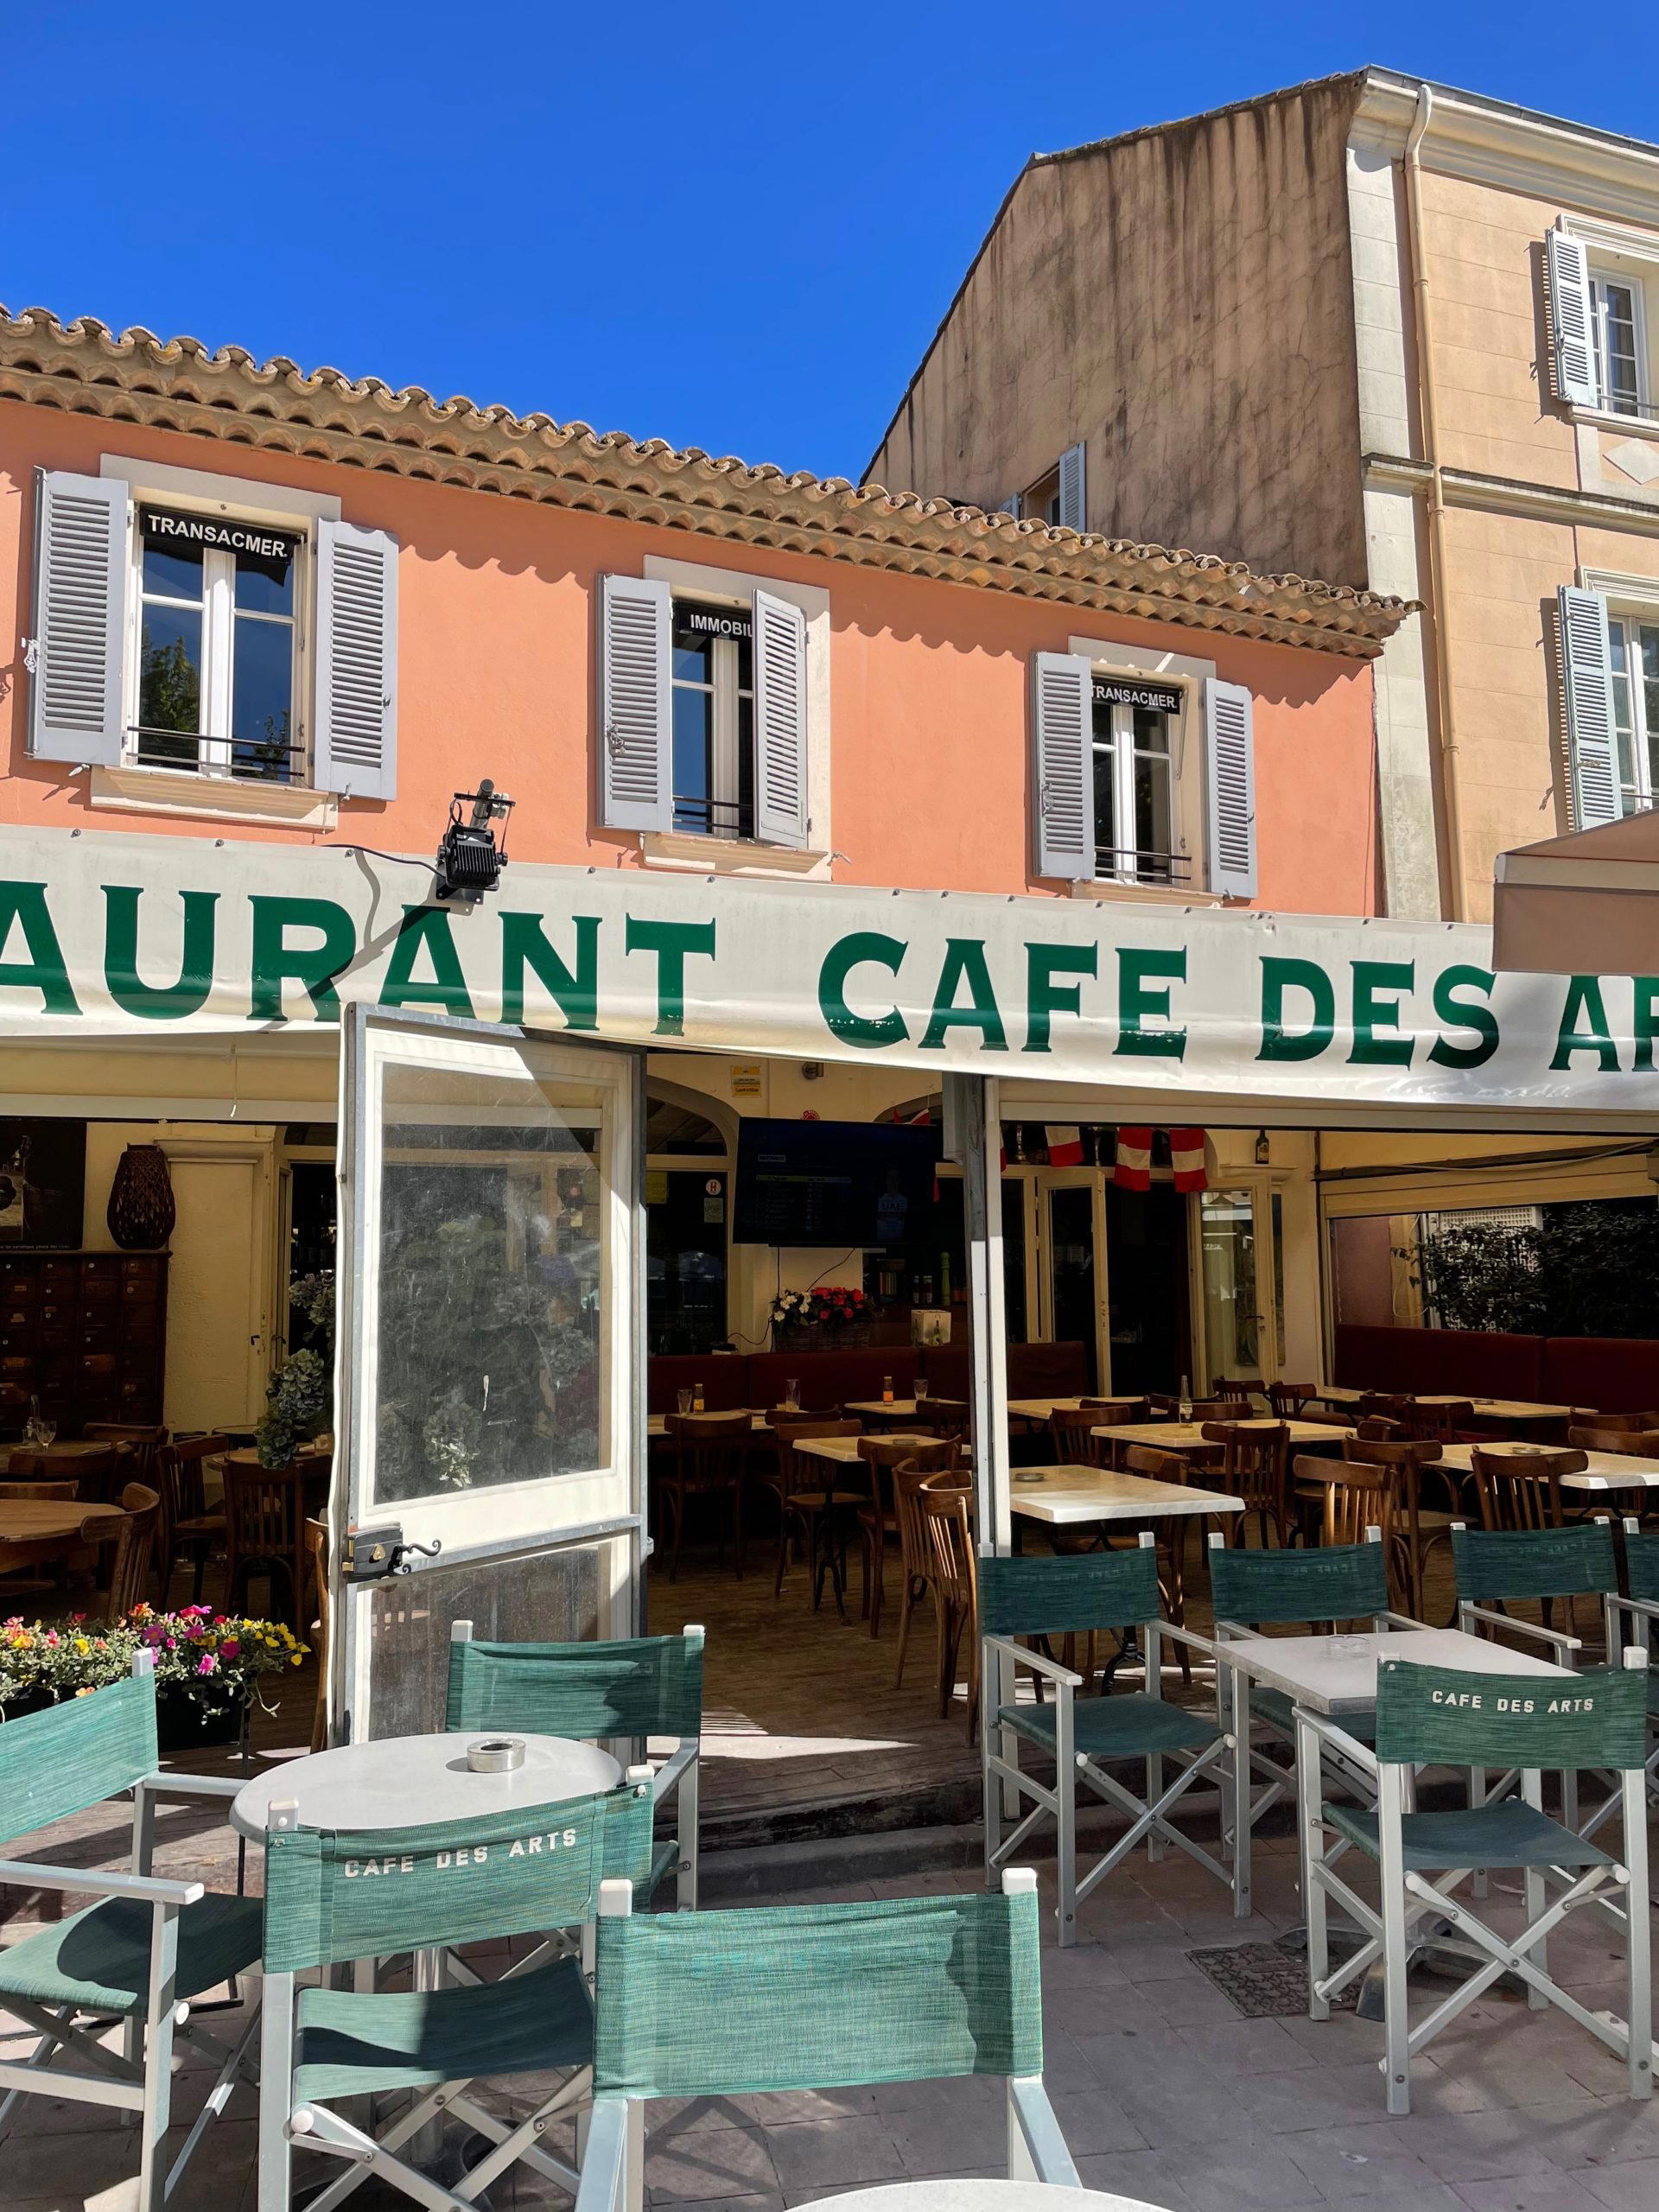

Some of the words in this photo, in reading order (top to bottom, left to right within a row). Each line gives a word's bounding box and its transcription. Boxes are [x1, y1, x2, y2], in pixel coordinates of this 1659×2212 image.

[0, 880, 716, 1035] AURANT
[819, 931, 1188, 1063] CAFE
[1255, 957, 1496, 1071] DES
[1432, 1690, 1482, 1709] CAFE
[1497, 1698, 1535, 1713] DES
[1547, 1698, 1593, 1713] ARTS
[345, 1855, 415, 1878] CAFE
[436, 1846, 488, 1869] DES
[508, 1828, 576, 1858] ARTS
